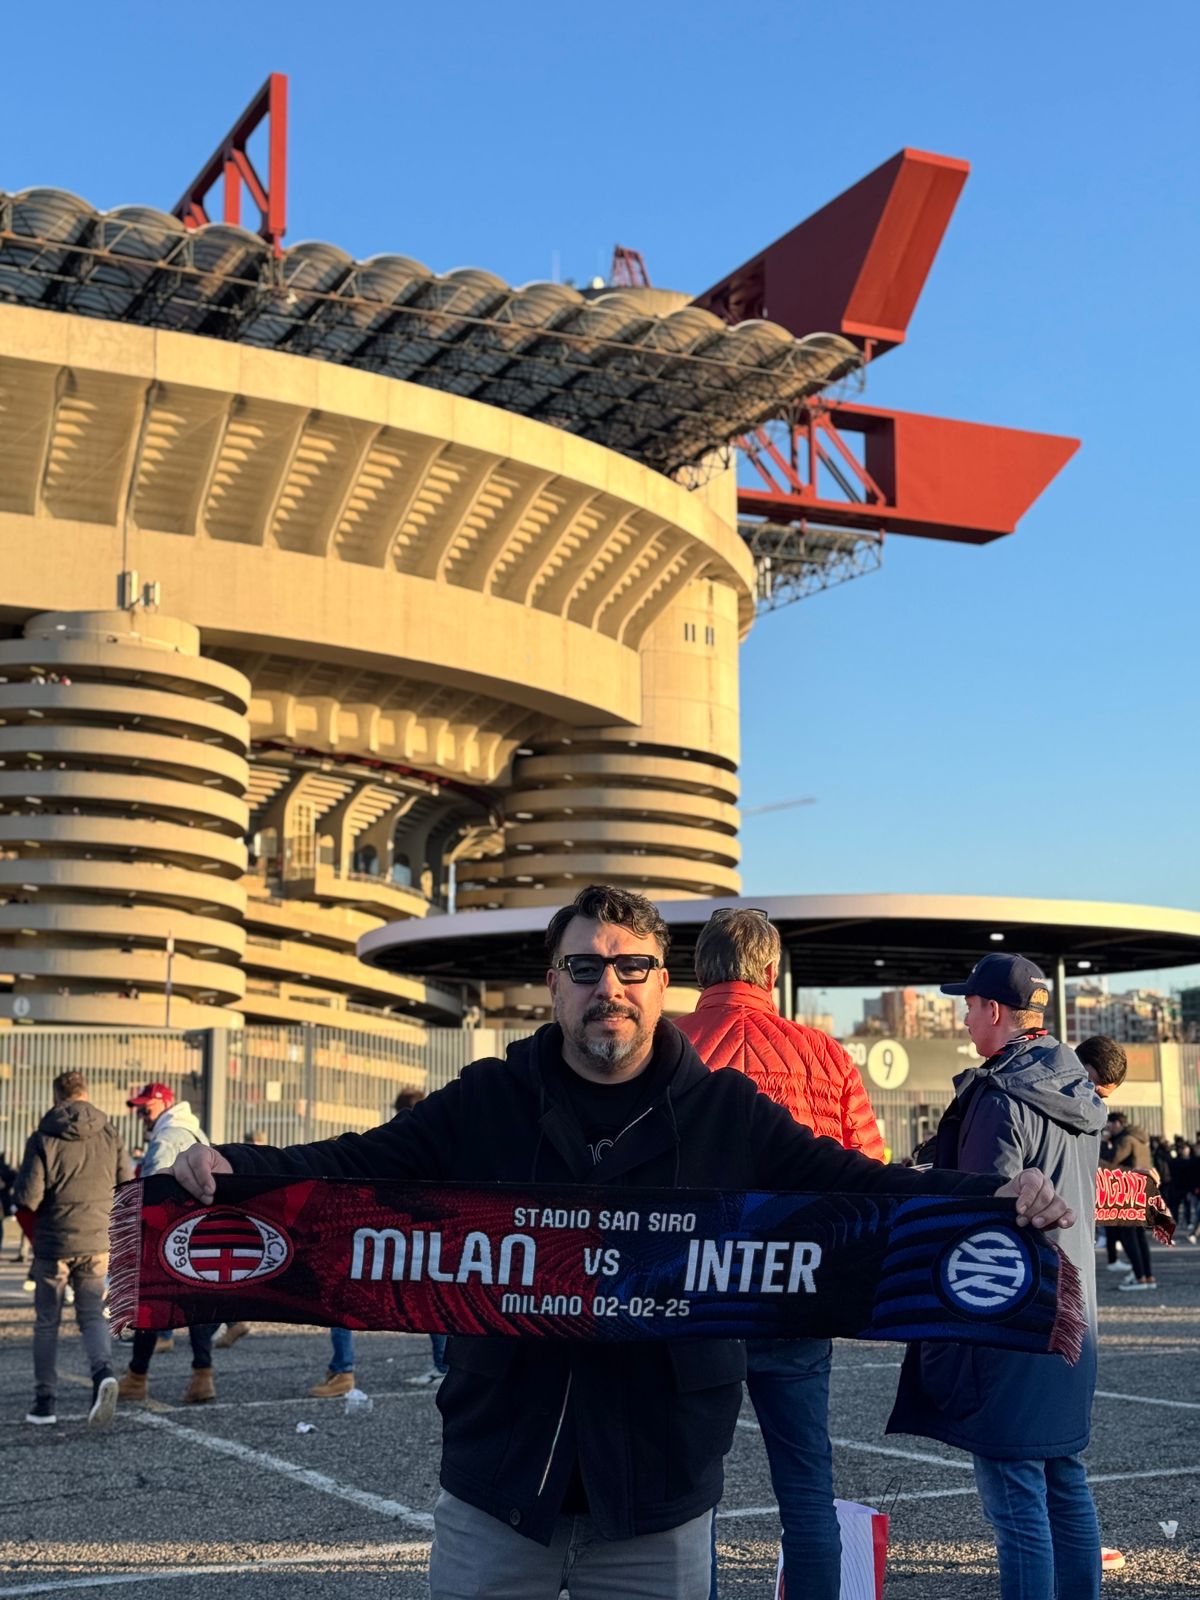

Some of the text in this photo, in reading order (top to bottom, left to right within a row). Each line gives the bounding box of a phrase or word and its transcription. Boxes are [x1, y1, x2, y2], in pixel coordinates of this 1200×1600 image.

[883, 1048, 893, 1081] 9
[514, 1207, 697, 1232] STADIO SAN SIRO
[1118, 1208, 1146, 1221] NOI
[172, 1227, 189, 1269] 1899
[259, 1224, 285, 1272] ACM
[351, 1227, 822, 1293] MILAN VS INTER
[501, 1294, 691, 1318] MILANO 02-02-25
